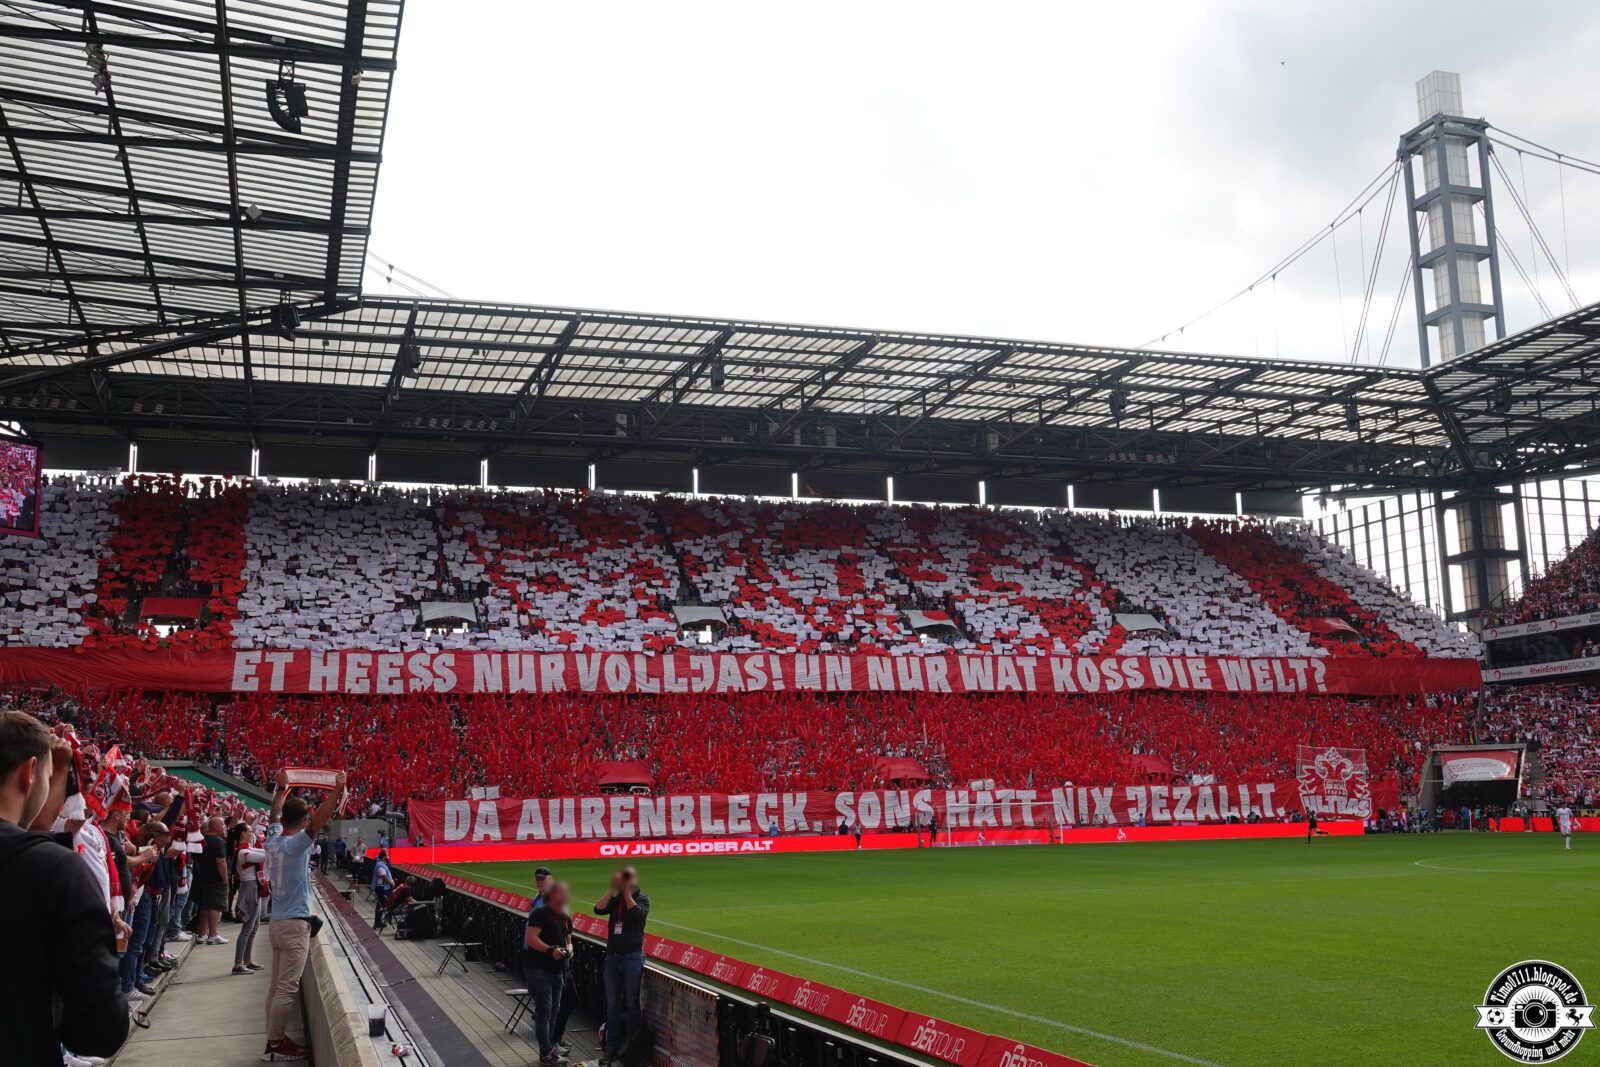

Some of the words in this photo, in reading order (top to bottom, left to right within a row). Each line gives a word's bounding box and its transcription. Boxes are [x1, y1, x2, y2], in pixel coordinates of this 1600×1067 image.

[231, 651, 294, 691] ET
[308, 652, 458, 694] HEESS
[473, 653, 568, 693] NUR
[795, 653, 852, 691] UN
[867, 655, 952, 692] NUR
[958, 655, 1038, 692] WAT
[1050, 657, 1145, 693] KOSS
[1149, 657, 1213, 690] DIE
[1217, 657, 1328, 693] WELT?
[835, 789, 935, 829] SONS
[1051, 786, 1118, 825] NIX
[1302, 795, 1370, 817] ULTRAS
[600, 844, 629, 856] OV
[631, 843, 684, 855] JUNG
[685, 841, 739, 853] ODER
[741, 840, 774, 851] ALT
[792, 981, 830, 1013] DERTOUR
[846, 998, 888, 1036] DERTOUR
[911, 1019, 966, 1061] DERTOUR
